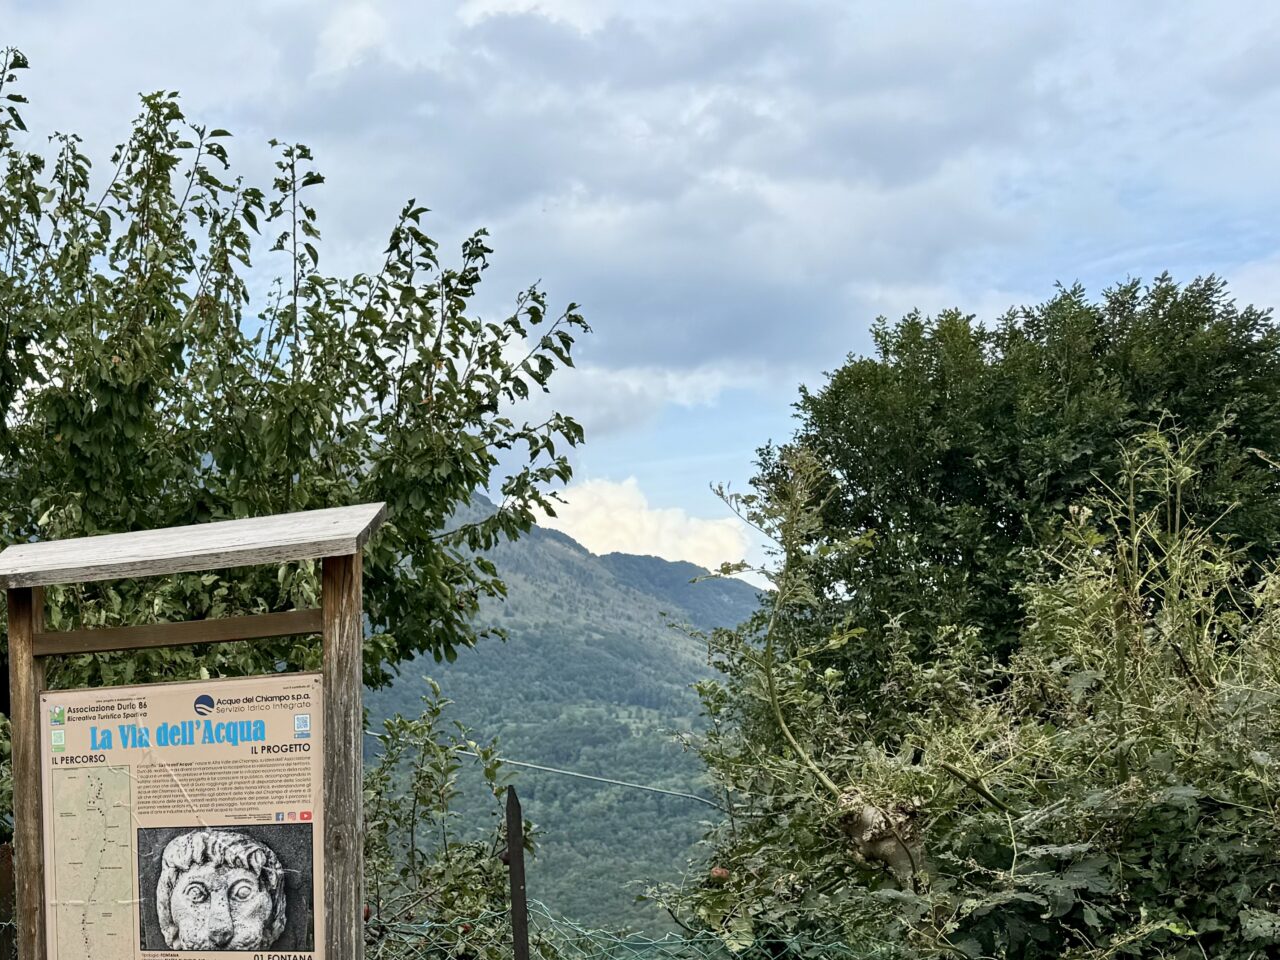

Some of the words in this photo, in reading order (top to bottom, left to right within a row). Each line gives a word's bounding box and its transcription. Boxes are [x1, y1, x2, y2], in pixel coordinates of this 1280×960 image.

[256, 695, 290, 703] Chiampo
[67, 704, 115, 713] Associazione
[273, 701, 311, 710] Integrato
[90, 726, 112, 750] La
[118, 724, 150, 748] Via
[156, 719, 265, 747] dell'Acqua
[251, 746, 258, 754] IL
[261, 743, 311, 753] PROGETTO
[61, 754, 106, 764] PERCORSO
